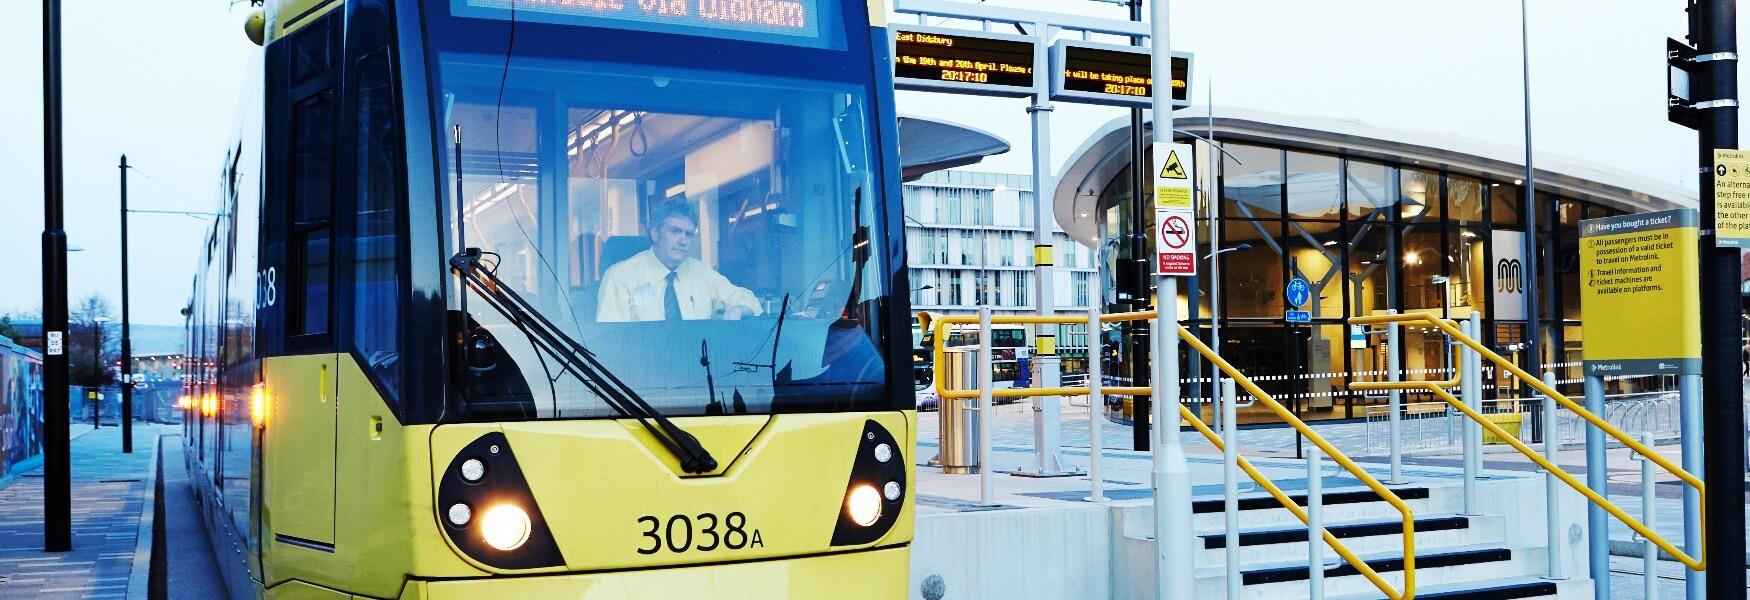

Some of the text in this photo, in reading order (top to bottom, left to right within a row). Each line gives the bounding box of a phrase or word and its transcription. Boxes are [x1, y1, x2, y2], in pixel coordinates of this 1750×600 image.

[896, 32, 953, 47] East Didsbury
[903, 56, 916, 65] the
[919, 57, 936, 66] 19th
[939, 60, 953, 68] and
[955, 60, 973, 69] 20th
[1000, 63, 1025, 74] Please
[941, 69, 988, 82] 20:17:10
[1073, 71, 1087, 79] will
[1090, 72, 1099, 80] be
[1101, 73, 1124, 84] taking
[1125, 75, 1145, 84] place
[1104, 83, 1146, 96] 20:17:10
[1717, 191, 1732, 200] step
[1732, 190, 1746, 199] free
[1717, 211, 1748, 219] the other
[1596, 223, 1611, 231] Have
[1611, 223, 1622, 231] you
[1623, 219, 1645, 229] bought
[1649, 215, 1672, 225] ticket?
[1725, 221, 1738, 229] the
[1604, 236, 1637, 248] passengers
[1637, 234, 1653, 243] must
[1653, 233, 1662, 241] be
[1662, 232, 1669, 240] in
[1596, 246, 1627, 257] possession
[1628, 245, 1635, 253] of
[1640, 243, 1655, 252] valid
[1655, 241, 1674, 250] ticket
[1603, 255, 1620, 265] travel
[1629, 252, 1660, 262] Metrolink.
[1597, 264, 1662, 276] Travel information and
[1597, 274, 1653, 286] ticket machines are
[1597, 283, 1663, 295] available on platforms.
[1597, 363, 1622, 371] Metrolink
